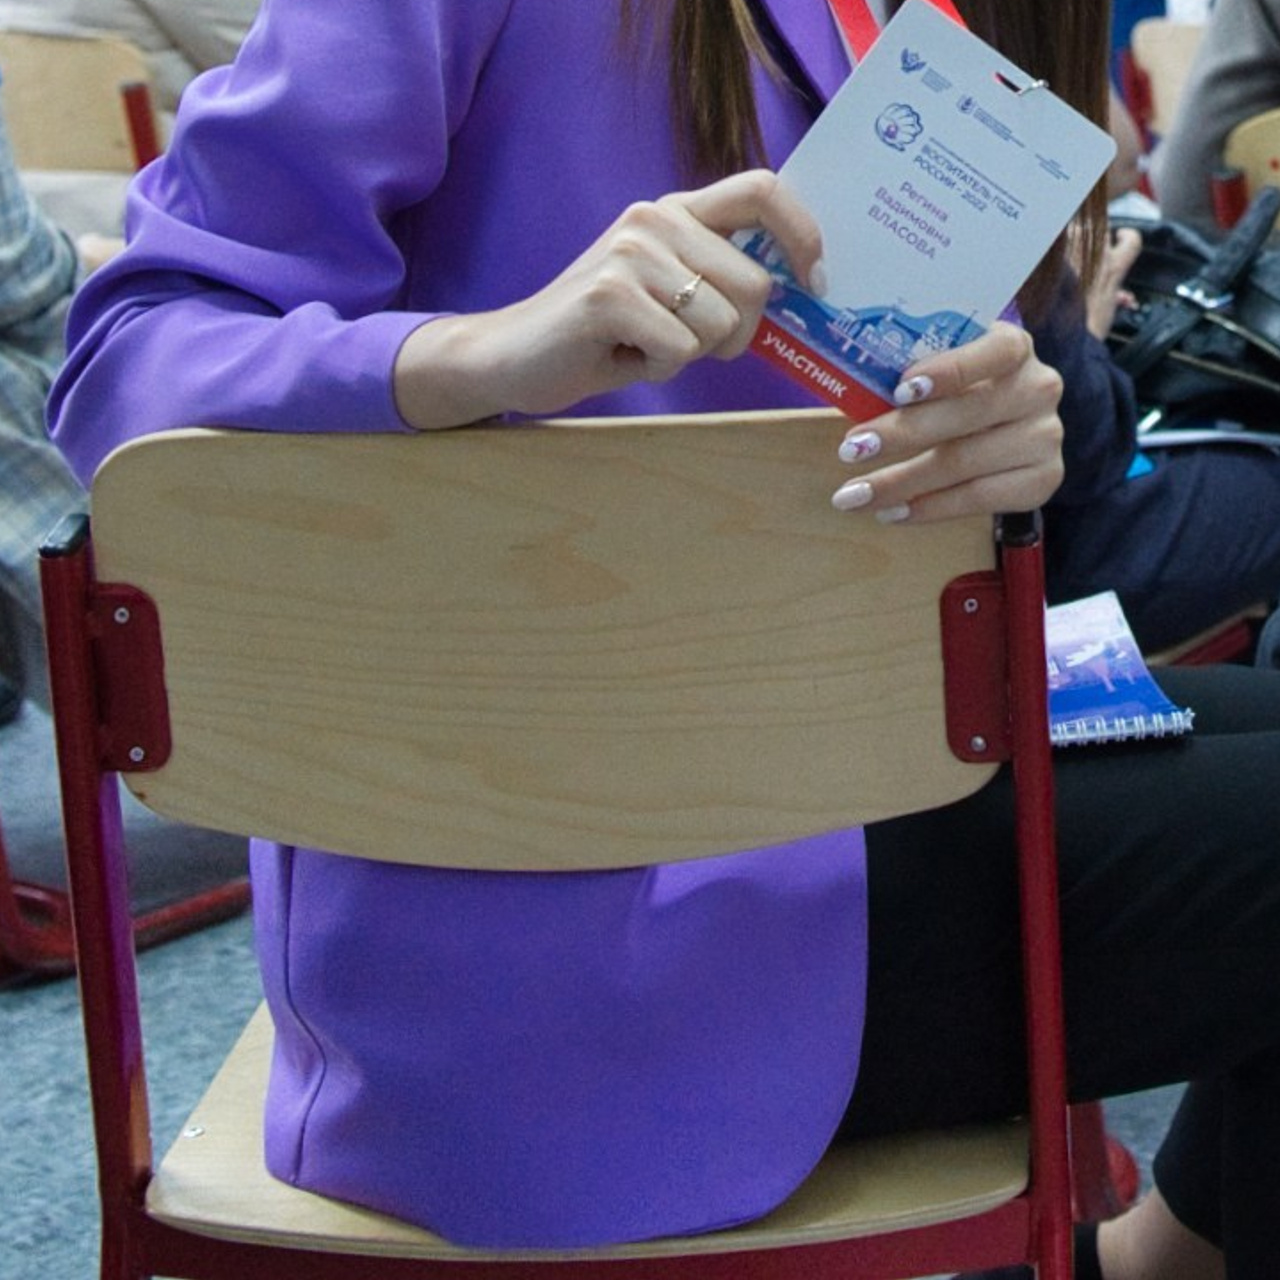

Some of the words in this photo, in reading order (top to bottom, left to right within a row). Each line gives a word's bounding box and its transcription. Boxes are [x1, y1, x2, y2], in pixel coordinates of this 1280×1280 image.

[900, 180, 949, 223] Регина
[913, 155, 957, 190] РОССИИ
[960, 189, 988, 213] 2022
[921, 144, 992, 202] ВОСПИТАТЕЛЬ
[992, 195, 1021, 221] ГОДА
[868, 204, 937, 260] ВЛАСОВА
[874, 186, 952, 249] Вадимовна
[762, 331, 847, 398] УЧАСТНИК
